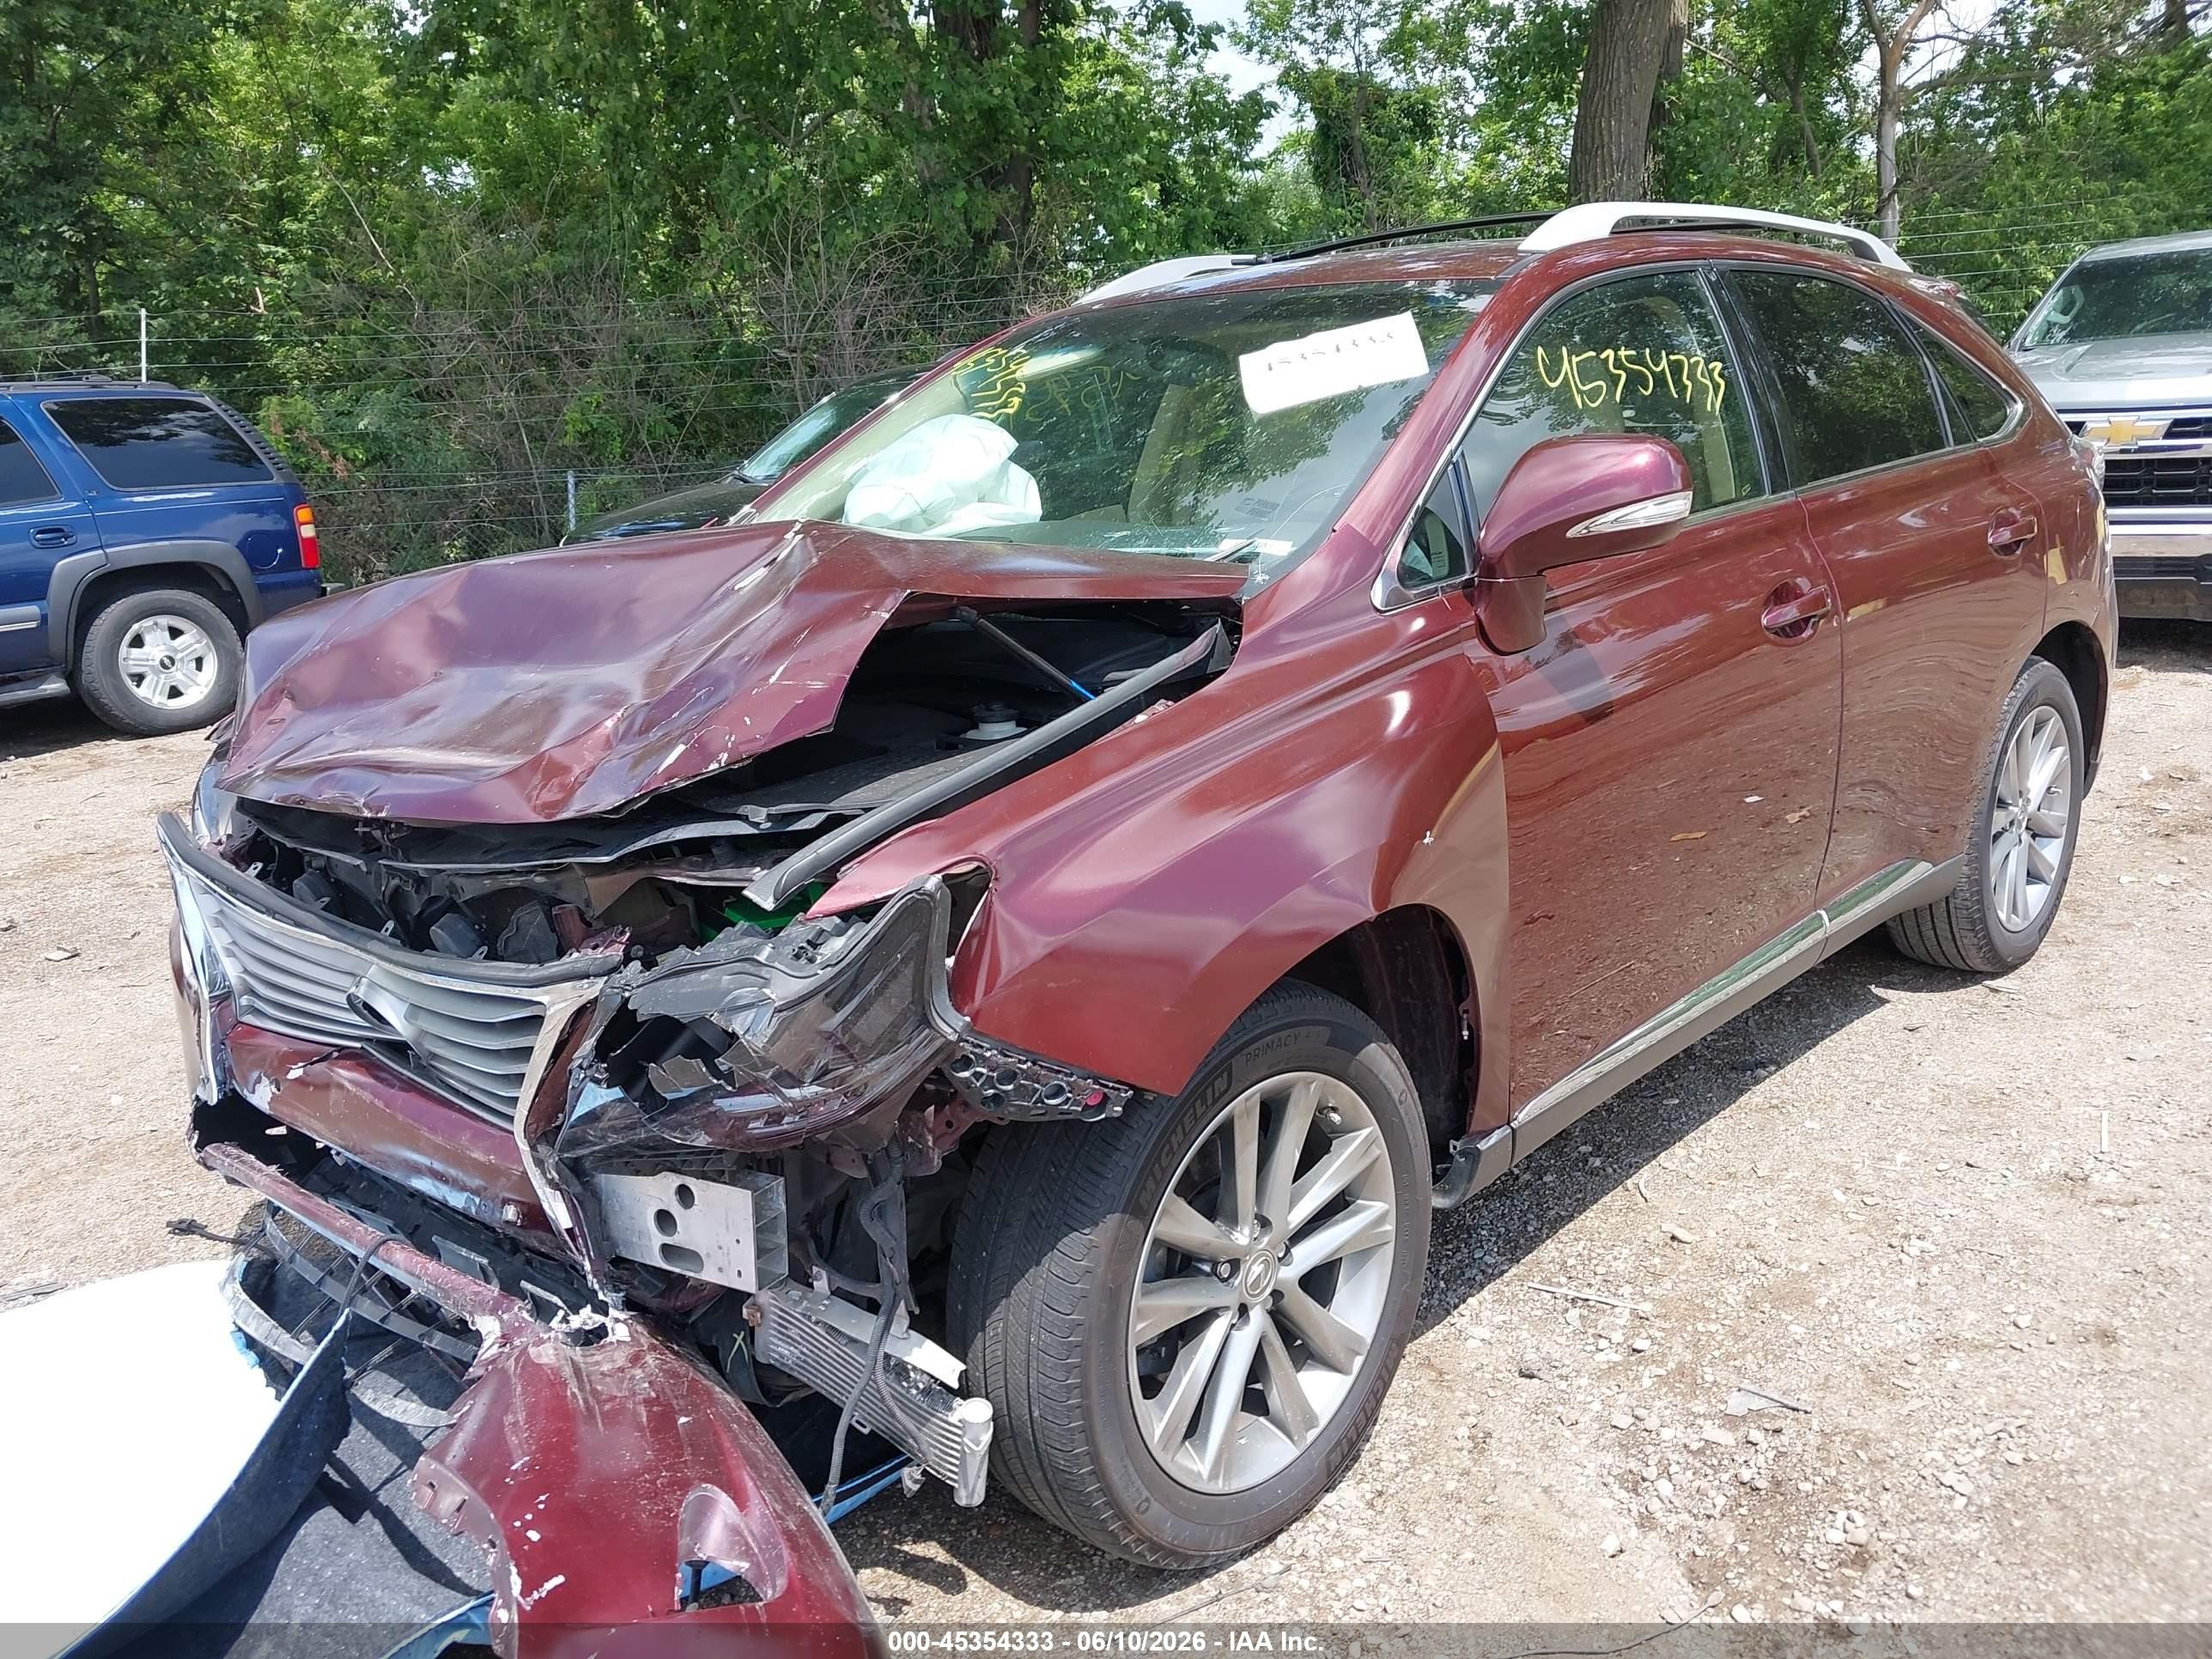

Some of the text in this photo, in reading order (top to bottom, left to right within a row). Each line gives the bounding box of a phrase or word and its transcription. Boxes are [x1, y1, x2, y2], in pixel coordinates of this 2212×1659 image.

[1537, 345, 1726, 416] 45354333
[1243, 1032, 1301, 1067] PRIMACY
[1137, 1069, 1233, 1209] MICHELIN
